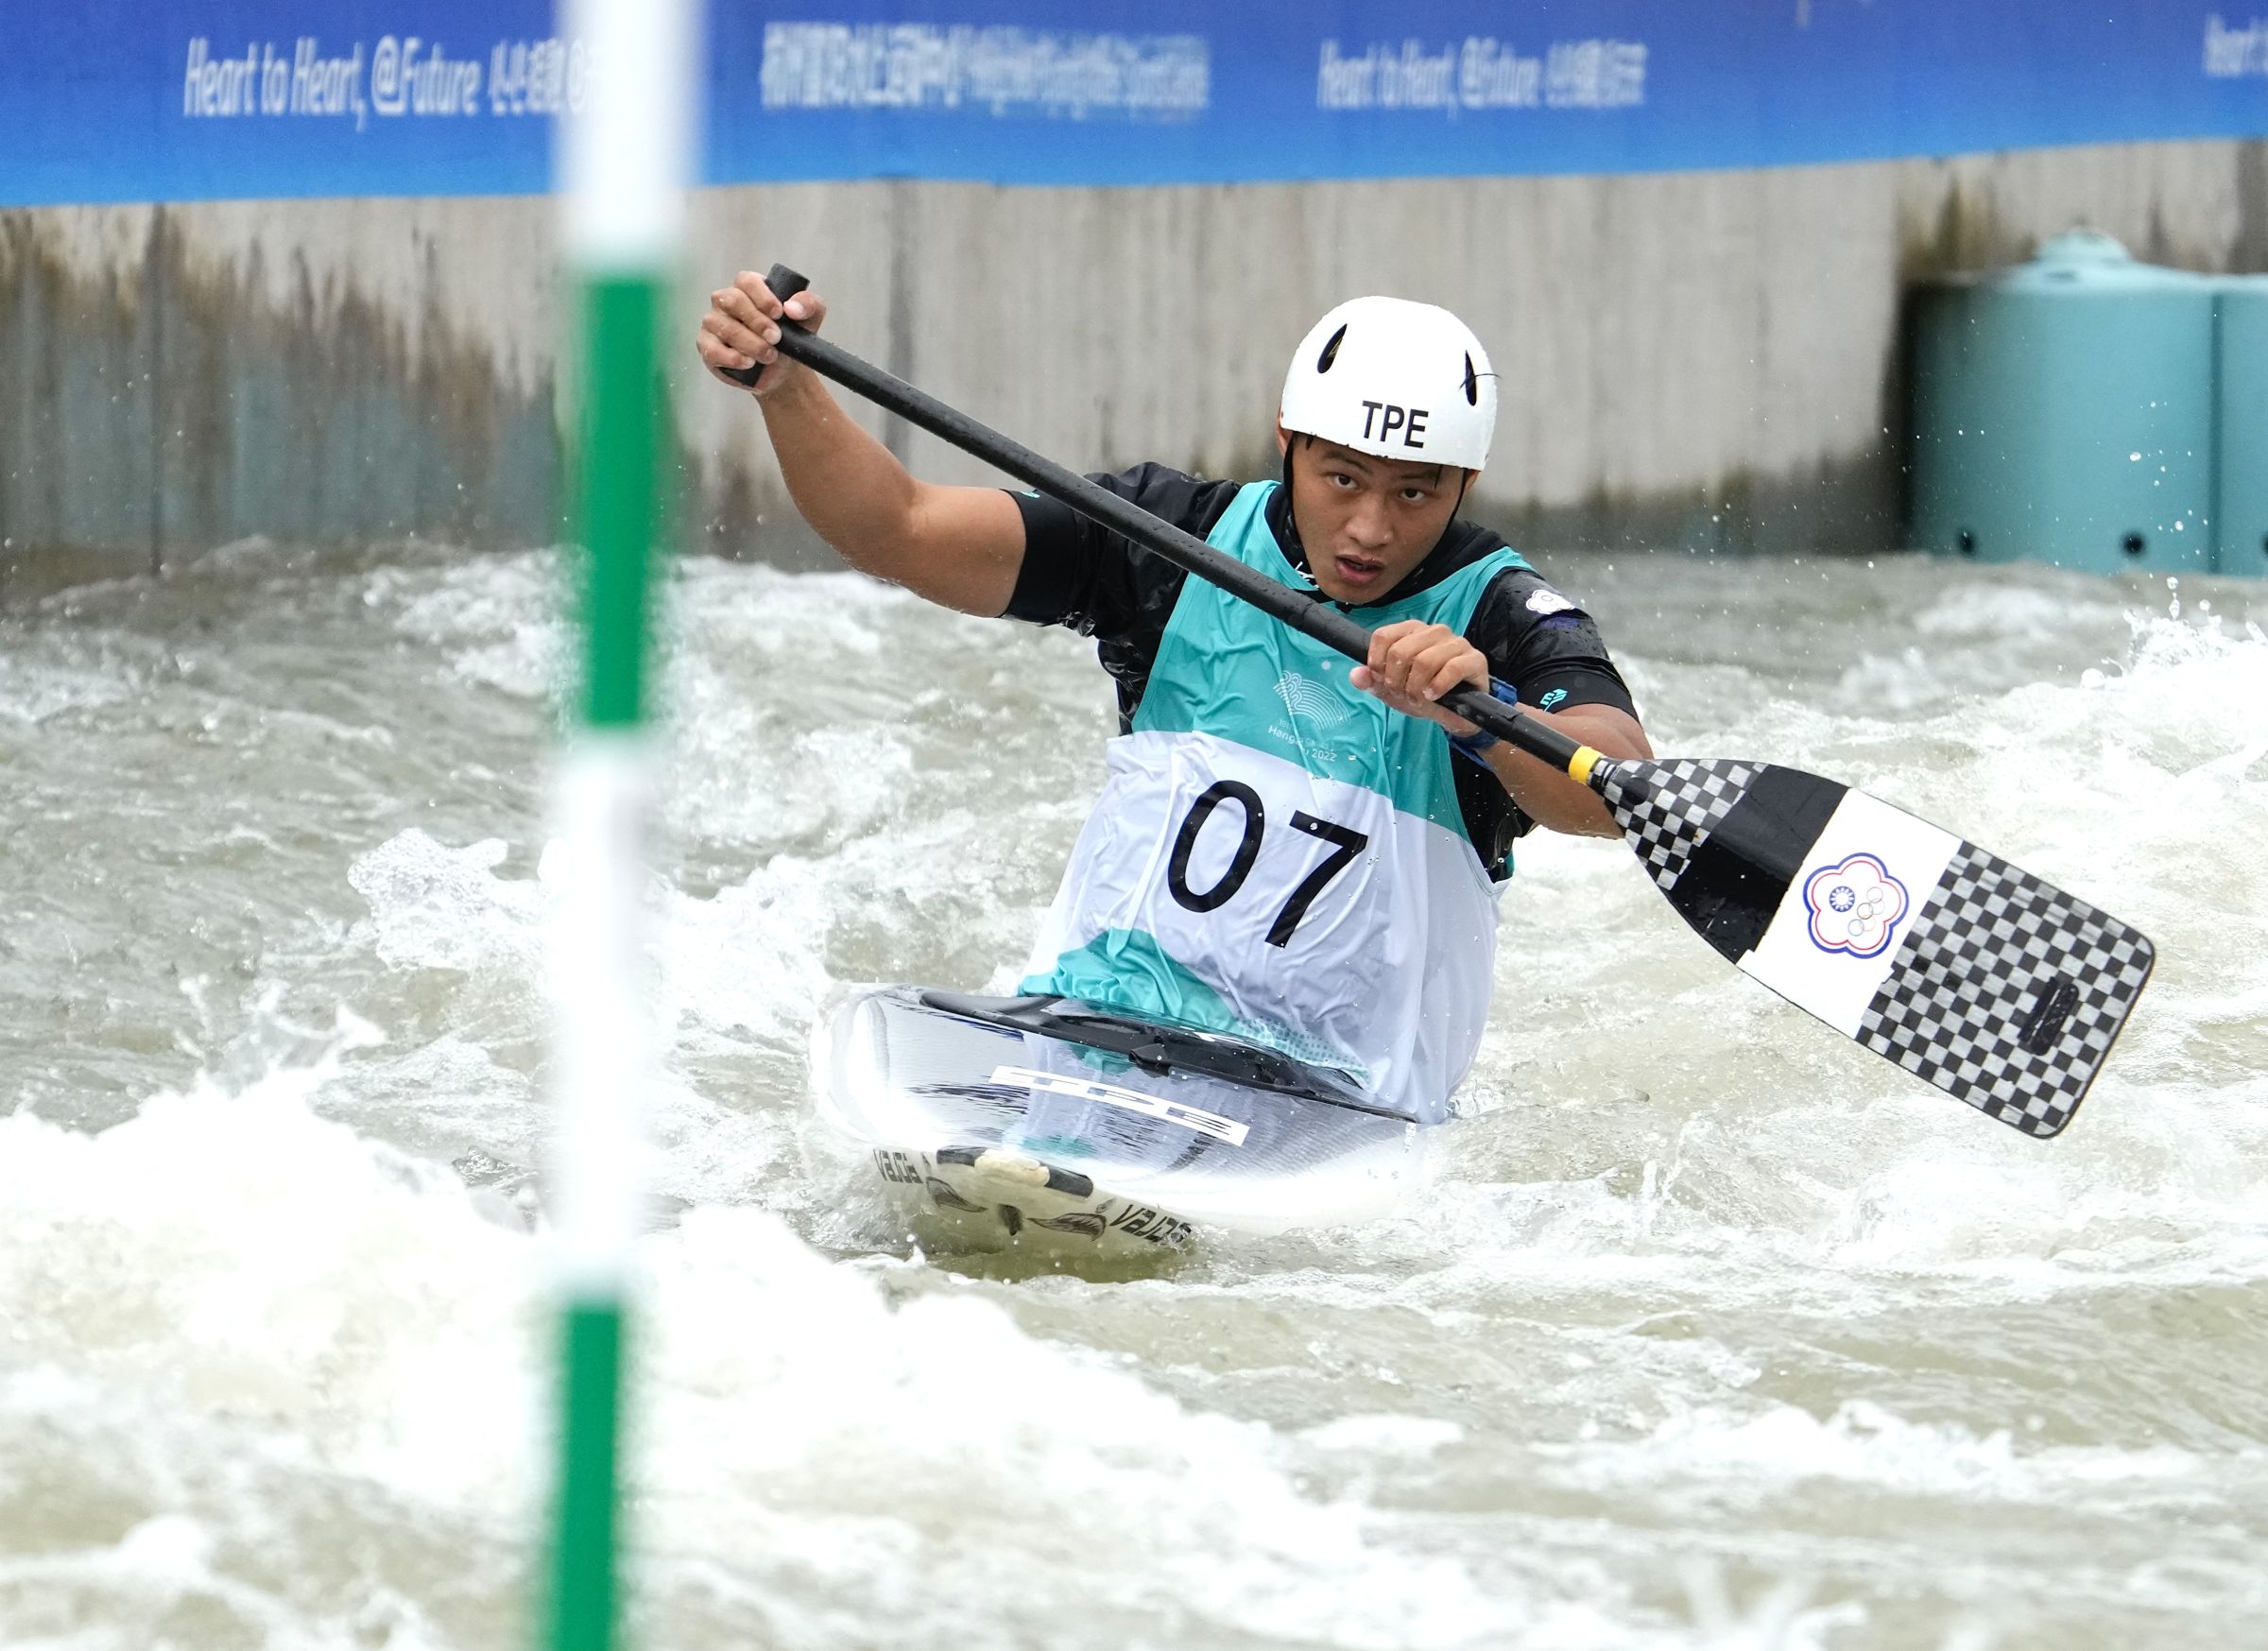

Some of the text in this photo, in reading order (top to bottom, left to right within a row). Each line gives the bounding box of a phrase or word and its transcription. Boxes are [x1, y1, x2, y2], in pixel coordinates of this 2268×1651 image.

[184, 38, 256, 115] Heart
[262, 43, 288, 115] to
[291, 37, 367, 132] Heart,
[371, 34, 482, 115] @Future
[1362, 400, 1429, 449] TPE
[1312, 748, 1338, 762] 2022
[1168, 780, 1368, 949] 07
